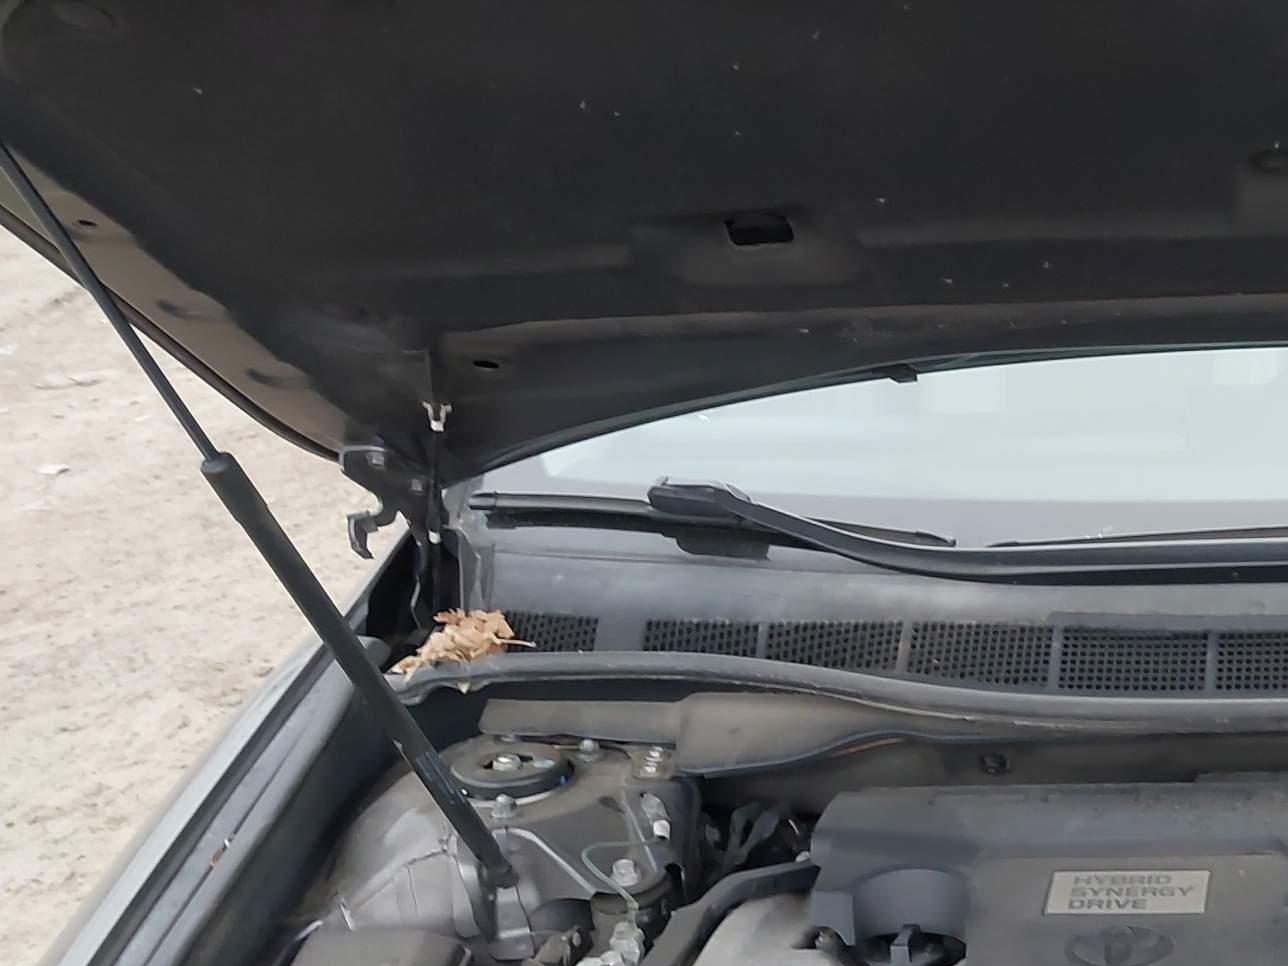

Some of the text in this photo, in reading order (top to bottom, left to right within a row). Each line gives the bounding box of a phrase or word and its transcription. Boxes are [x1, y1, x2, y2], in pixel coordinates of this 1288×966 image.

[1072, 875, 1173, 886] HYBRID
[1069, 886, 1194, 898] SYNERGY
[1067, 898, 1148, 910] DRIVE
